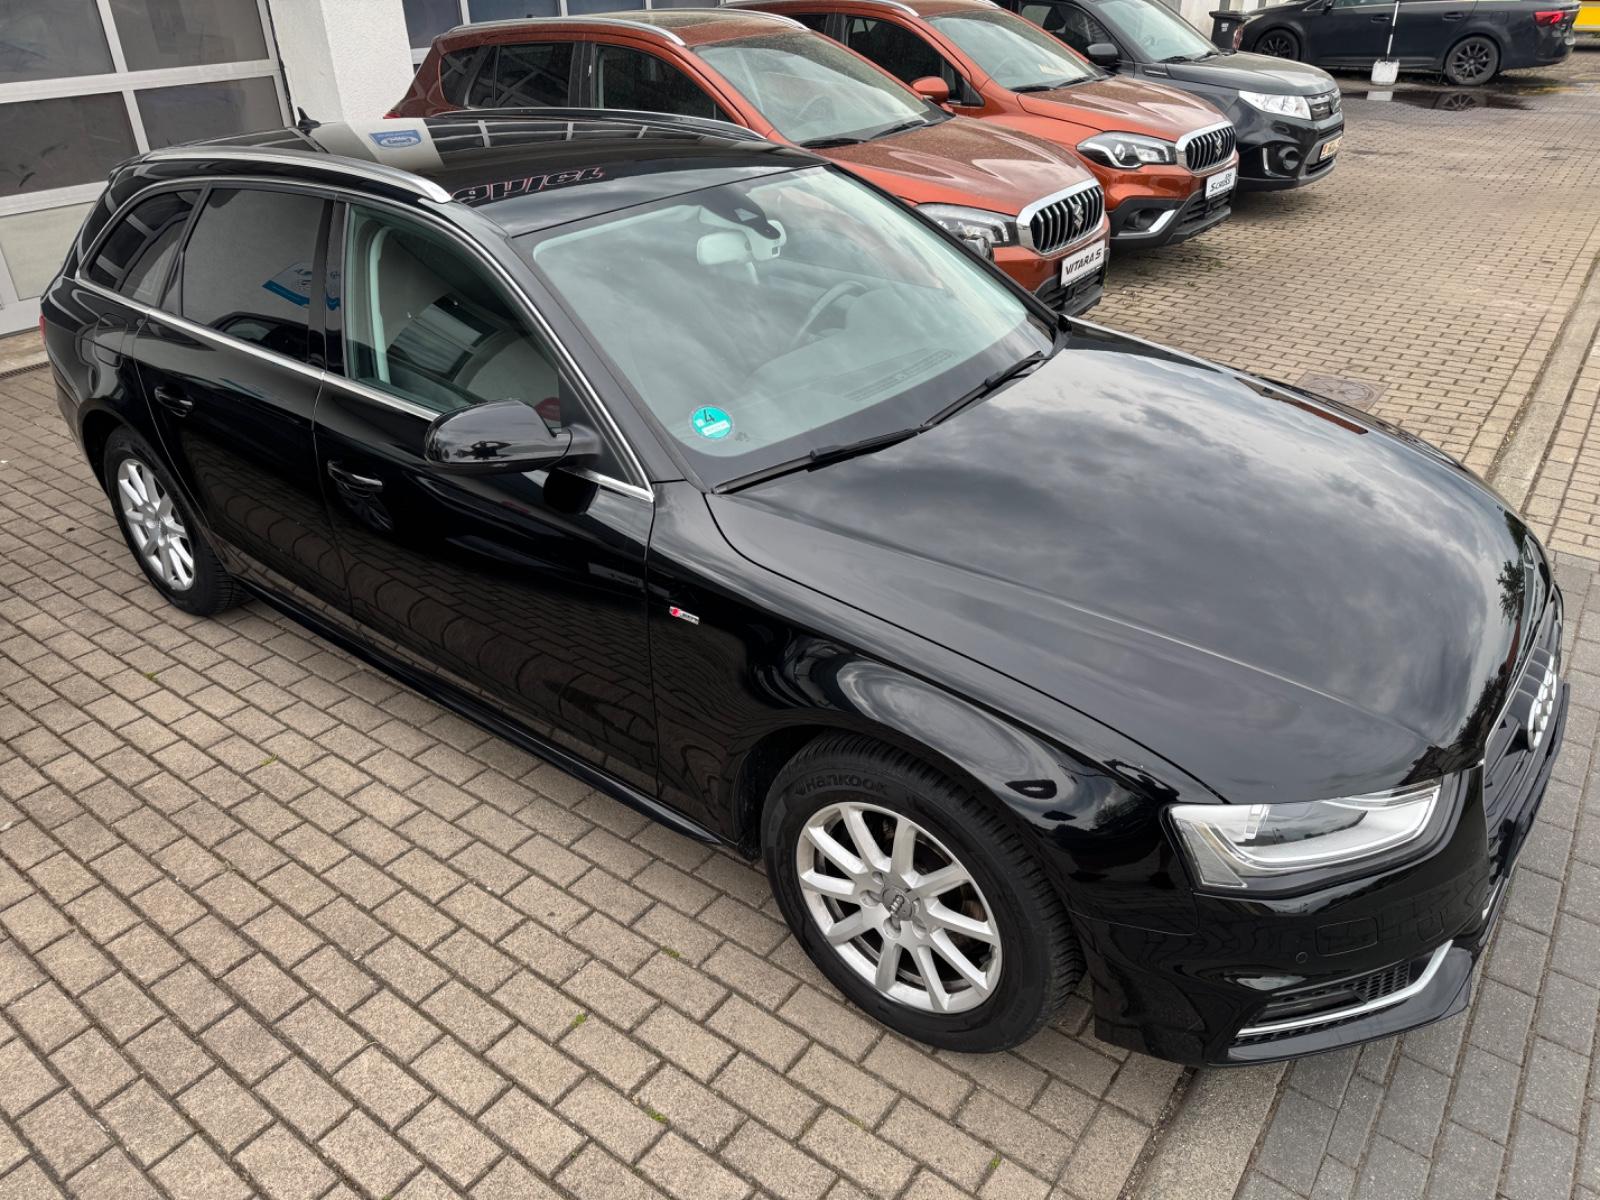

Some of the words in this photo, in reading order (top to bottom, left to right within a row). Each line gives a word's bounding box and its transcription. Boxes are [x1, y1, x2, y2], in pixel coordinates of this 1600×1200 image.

[1066, 252, 1094, 274] VITARA
[1095, 248, 1102, 260] S
[703, 408, 715, 422] 4
